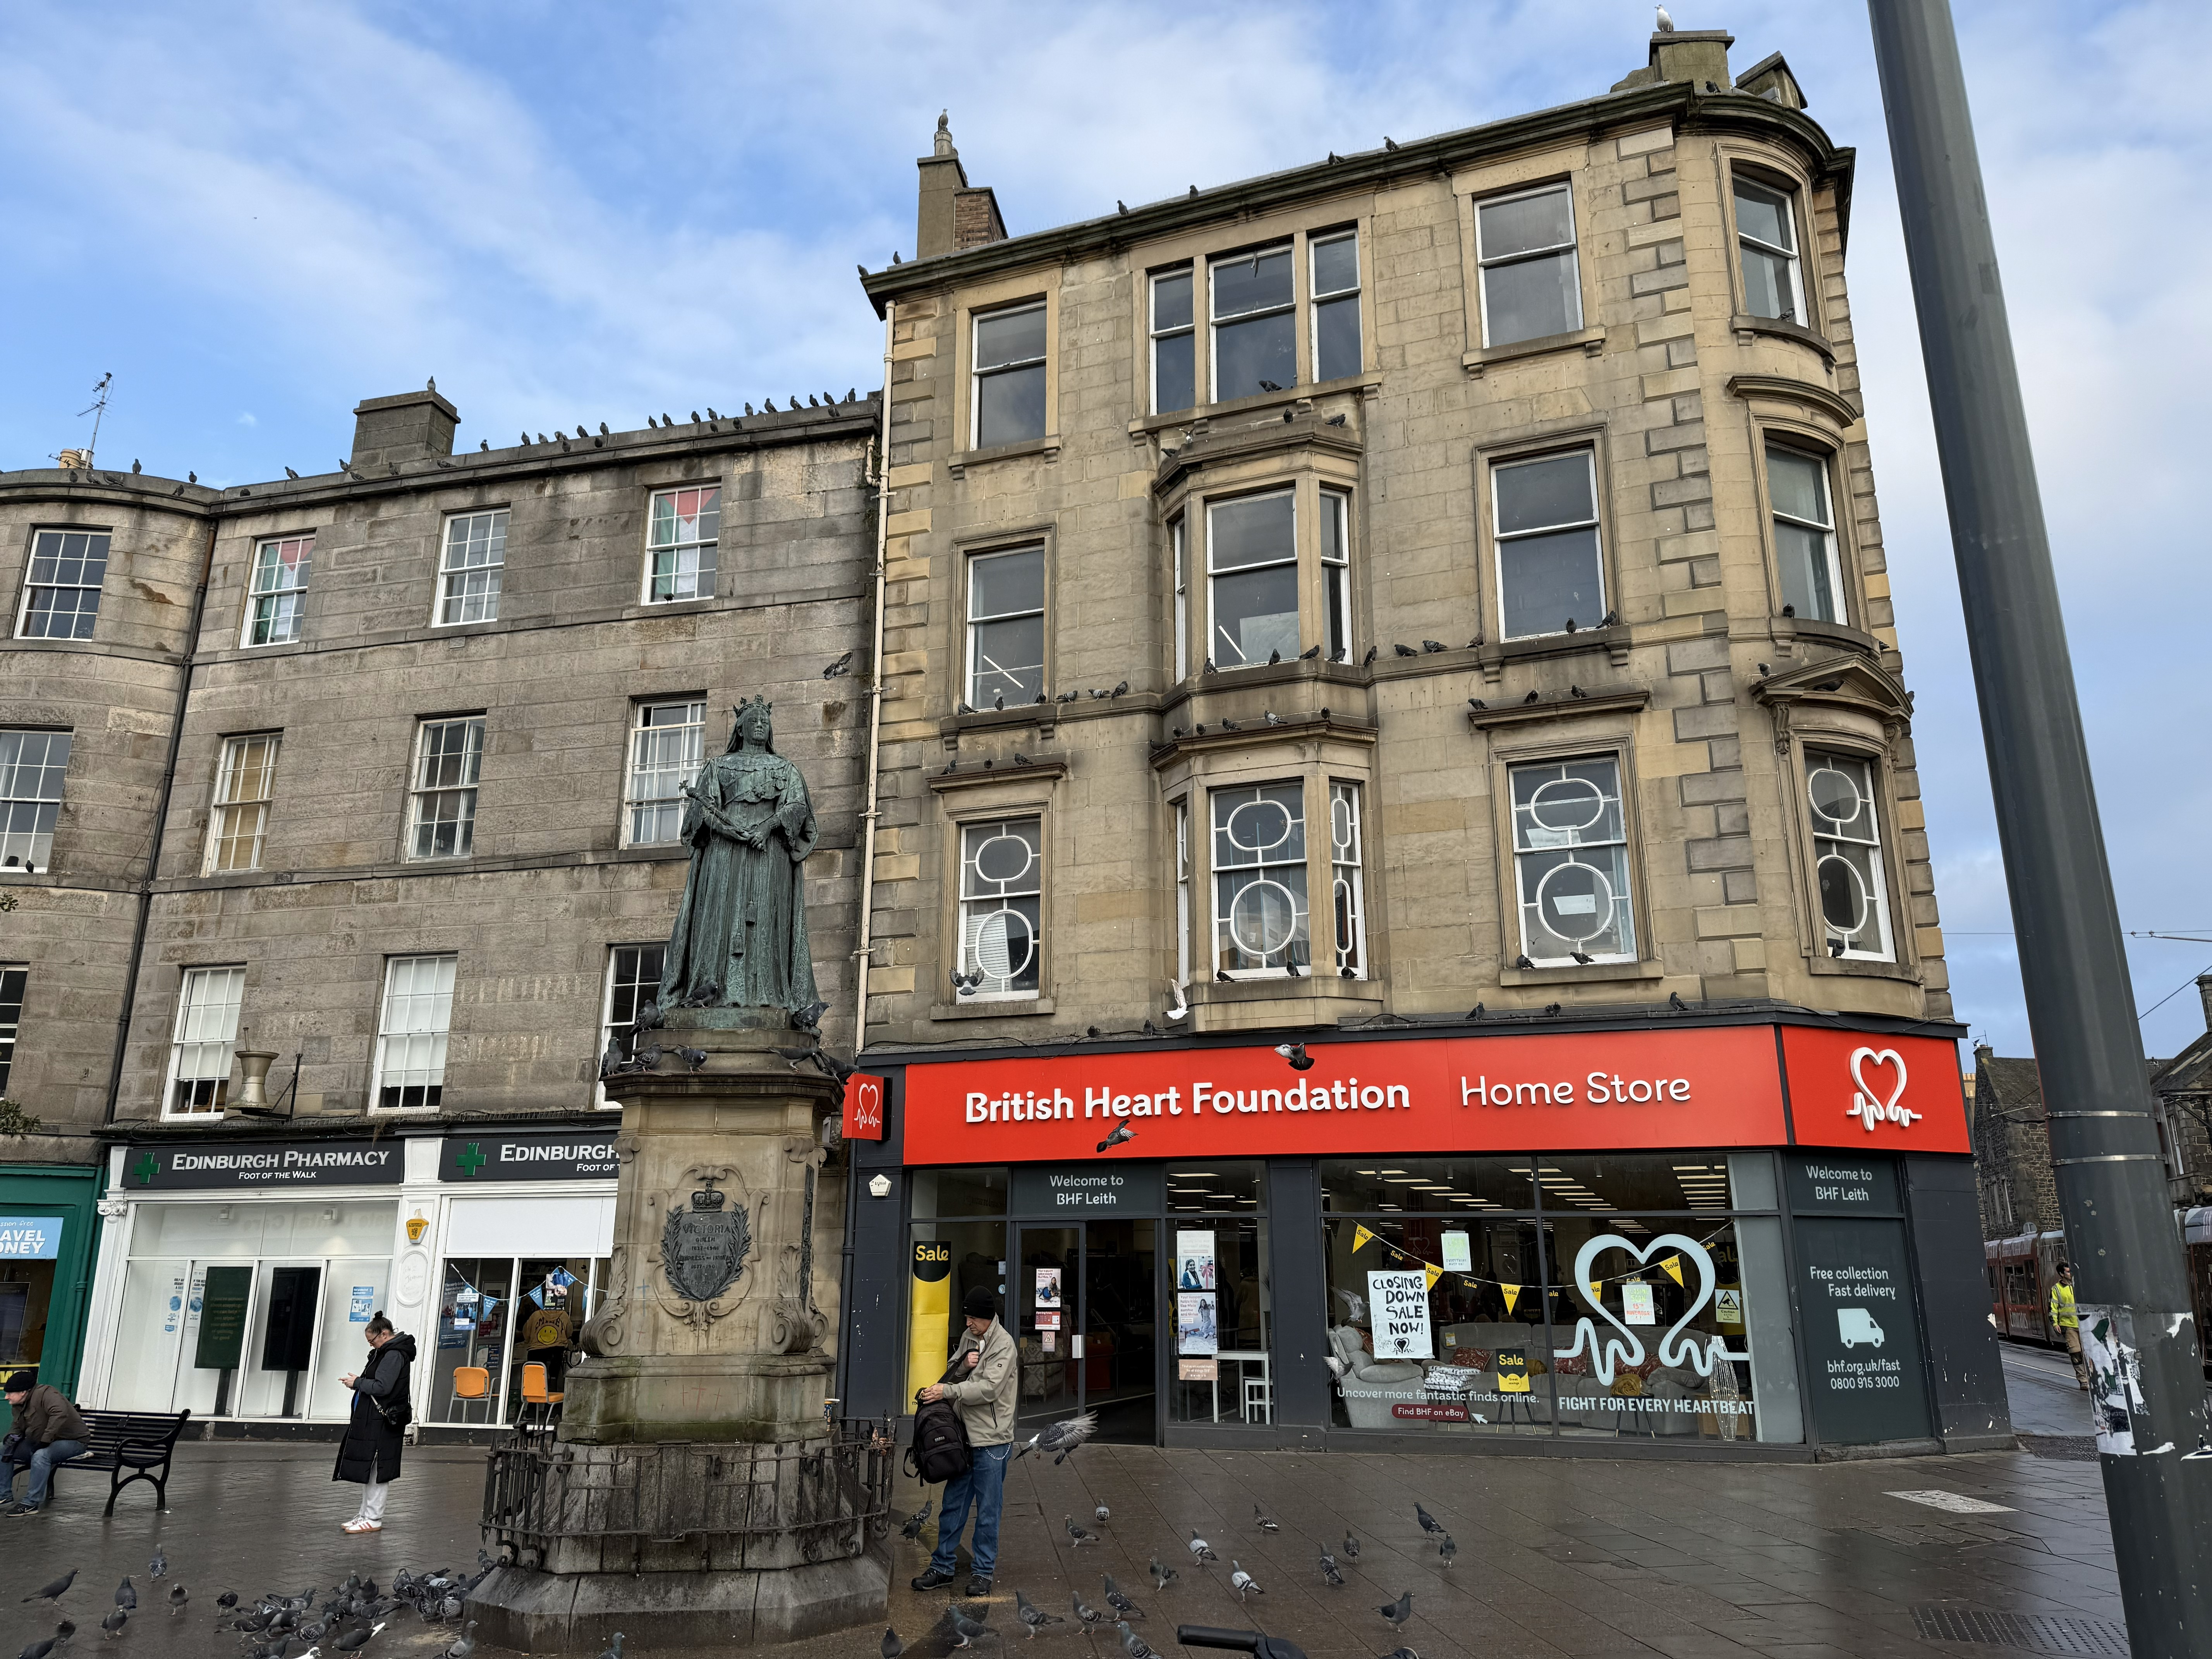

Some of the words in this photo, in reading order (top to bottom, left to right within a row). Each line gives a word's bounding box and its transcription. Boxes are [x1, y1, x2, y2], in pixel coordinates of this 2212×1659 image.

[1461, 1075, 1574, 1106] Home
[1587, 1072, 1692, 1104] Store
[966, 1088, 1074, 1123] British
[1085, 1087, 1183, 1118] Heart
[1193, 1078, 1410, 1114] Foundation
[172, 1153, 279, 1170] EDINBURGH
[283, 1151, 390, 1167] PHARMACY
[577, 1163, 601, 1171] FOOT
[1805, 1165, 1858, 1180] Welcome
[1860, 1168, 1872, 1180] to
[1049, 1175, 1107, 1187] Welcome
[1111, 1175, 1123, 1185] to
[1057, 1193, 1082, 1204] BHF
[1086, 1192, 1116, 1204] Leith
[1815, 1187, 1838, 1200] BHF
[1841, 1187, 1869, 1200] Leith
[683, 1224, 731, 1233] VICTORIA
[1357, 1230, 1368, 1240] Sale
[915, 1245, 948, 1261] Sale
[1391, 1250, 1403, 1261] Sale
[1427, 1267, 1439, 1277] Sale
[1665, 1262, 1679, 1270] Sale
[1810, 1266, 1833, 1279] Free
[1836, 1266, 1889, 1279] collection
[1373, 1276, 1423, 1290] CLOSING
[1464, 1280, 1477, 1289] Sale
[1386, 1290, 1425, 1304] DOWN
[1828, 1283, 1851, 1297] Fast
[1854, 1283, 1896, 1300] delivery
[1386, 1305, 1423, 1320] SALE
[1389, 1322, 1423, 1335] NOW!
[1499, 1354, 1524, 1365] Sale
[1827, 1358, 1901, 1376] bhf.org.uk/fast
[1831, 1377, 1855, 1389] 0800
[1857, 1377, 1873, 1388] 915
[1875, 1376, 1899, 1388] 3000
[1337, 1387, 1382, 1398] Uncover
[1416, 1389, 1466, 1401] fantastic
[1469, 1391, 1498, 1401] finds
[1501, 1392, 1539, 1403] online.
[1559, 1397, 1596, 1410] FIGHT
[1600, 1398, 1626, 1411] FOR
[1628, 1398, 1671, 1412] EVERY
[1674, 1399, 1754, 1414] HEARTBEAT
[1445, 1409, 1464, 1419] eBay
